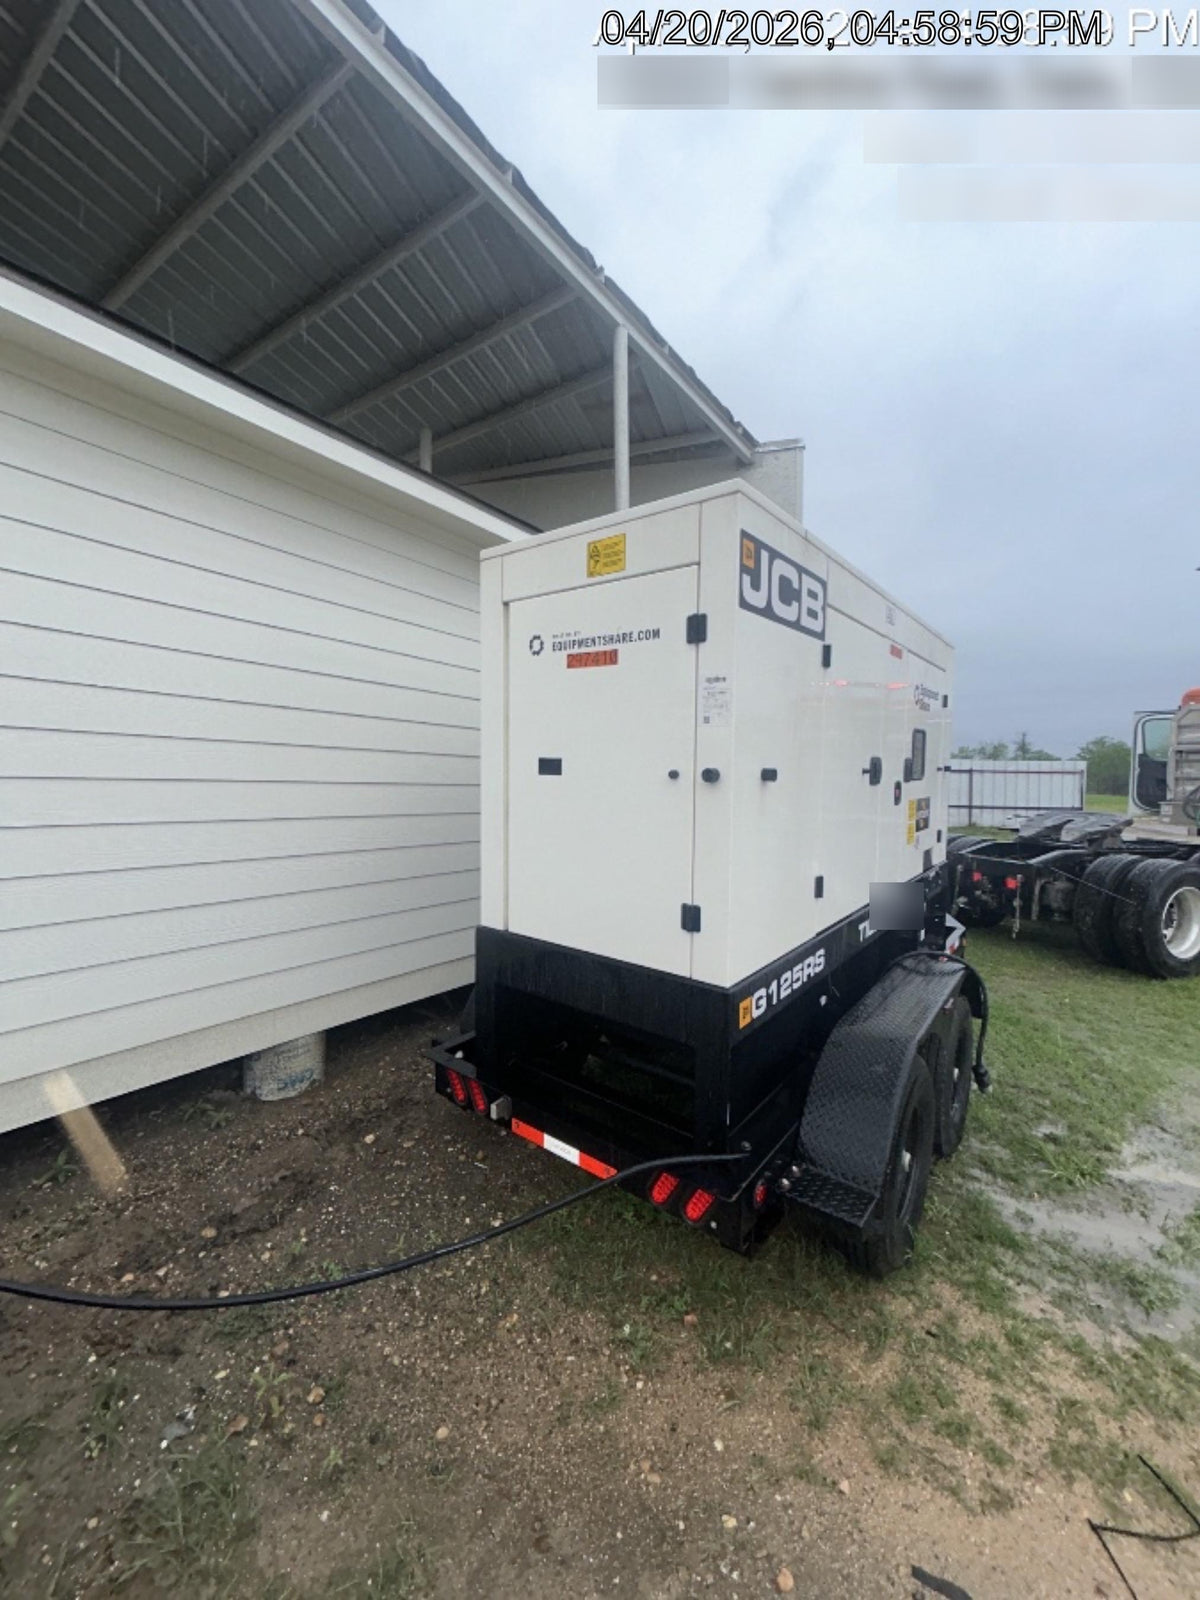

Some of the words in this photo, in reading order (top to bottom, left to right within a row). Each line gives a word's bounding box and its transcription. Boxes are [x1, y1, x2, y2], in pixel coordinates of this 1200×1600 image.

[741, 548, 825, 634] JCB
[551, 627, 661, 652] EQUIPMENTSHARE.COM
[751, 947, 826, 1020] G125RS
